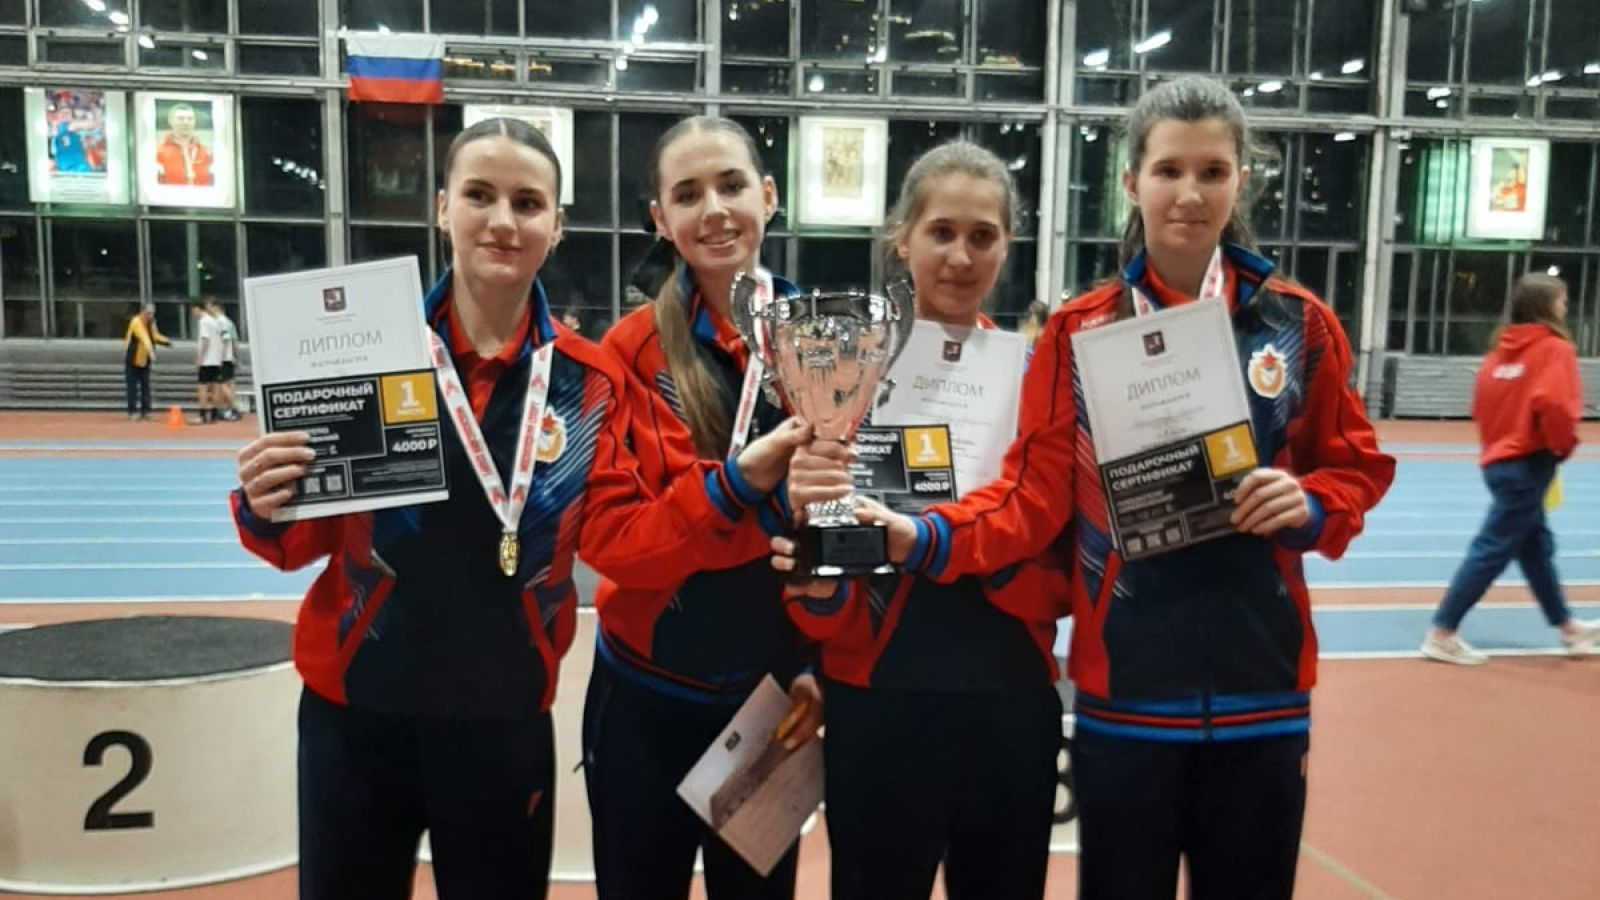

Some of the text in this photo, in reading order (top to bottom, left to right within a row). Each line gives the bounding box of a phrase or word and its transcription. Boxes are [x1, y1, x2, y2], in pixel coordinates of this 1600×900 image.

[299, 330, 383, 357] ДИПЛОМ
[272, 382, 374, 404] ПОДАРОЧНЫЙ
[401, 380, 421, 408] 1
[912, 374, 984, 399] ДИПЛОМ
[1127, 367, 1201, 400] ДИПЛОМ
[274, 399, 366, 418] СЕРТИФИКАТ
[391, 438, 427, 453] 4000
[919, 432, 937, 454] 1
[1224, 435, 1243, 461] 1
[1109, 444, 1201, 479] ПОДАРОЧНЫЙ
[1112, 460, 1194, 491] СЕРТИФИКАТ
[83, 730, 154, 830] 2
